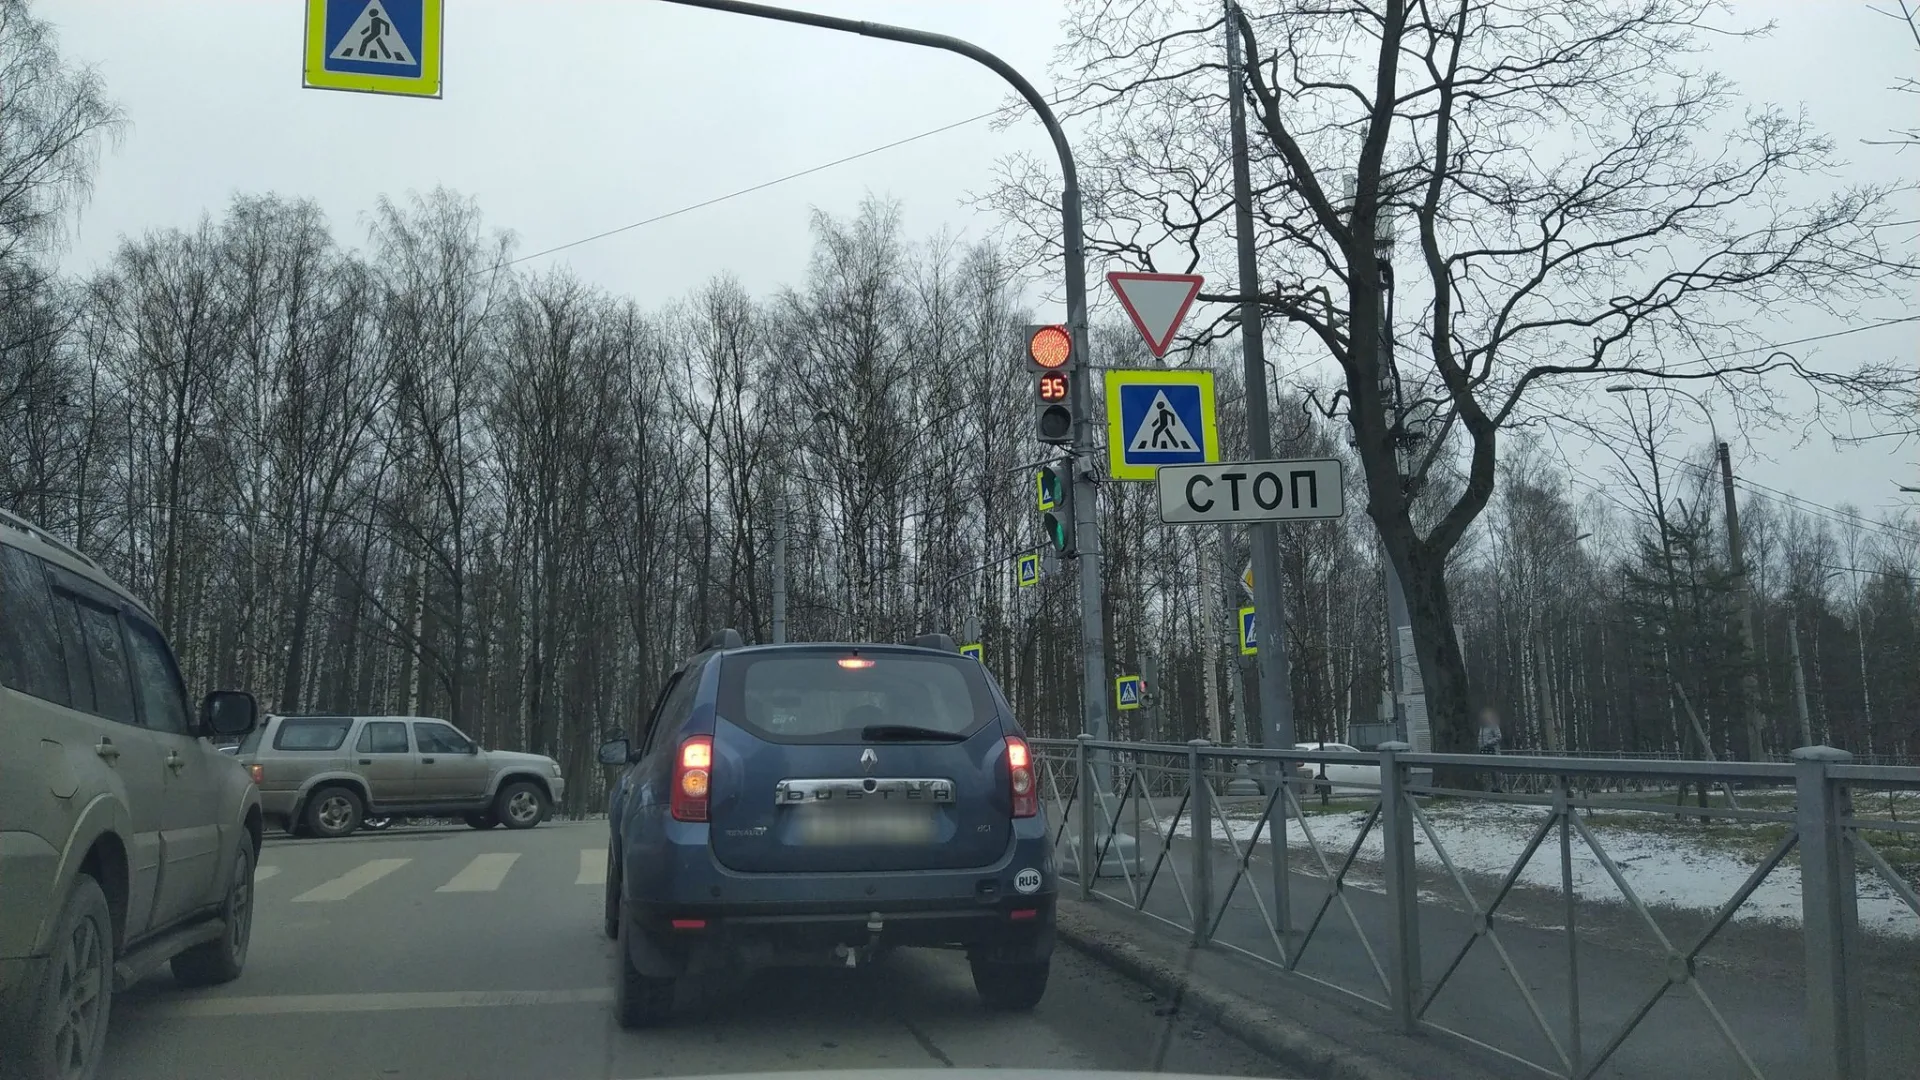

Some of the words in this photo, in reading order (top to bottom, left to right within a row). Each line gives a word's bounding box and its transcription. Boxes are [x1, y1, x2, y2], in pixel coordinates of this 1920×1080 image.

[1041, 378, 1065, 398] 35
[1186, 470, 1318, 513] СТОП
[787, 789, 949, 800] DUSTER
[1018, 875, 1039, 887] RUS
